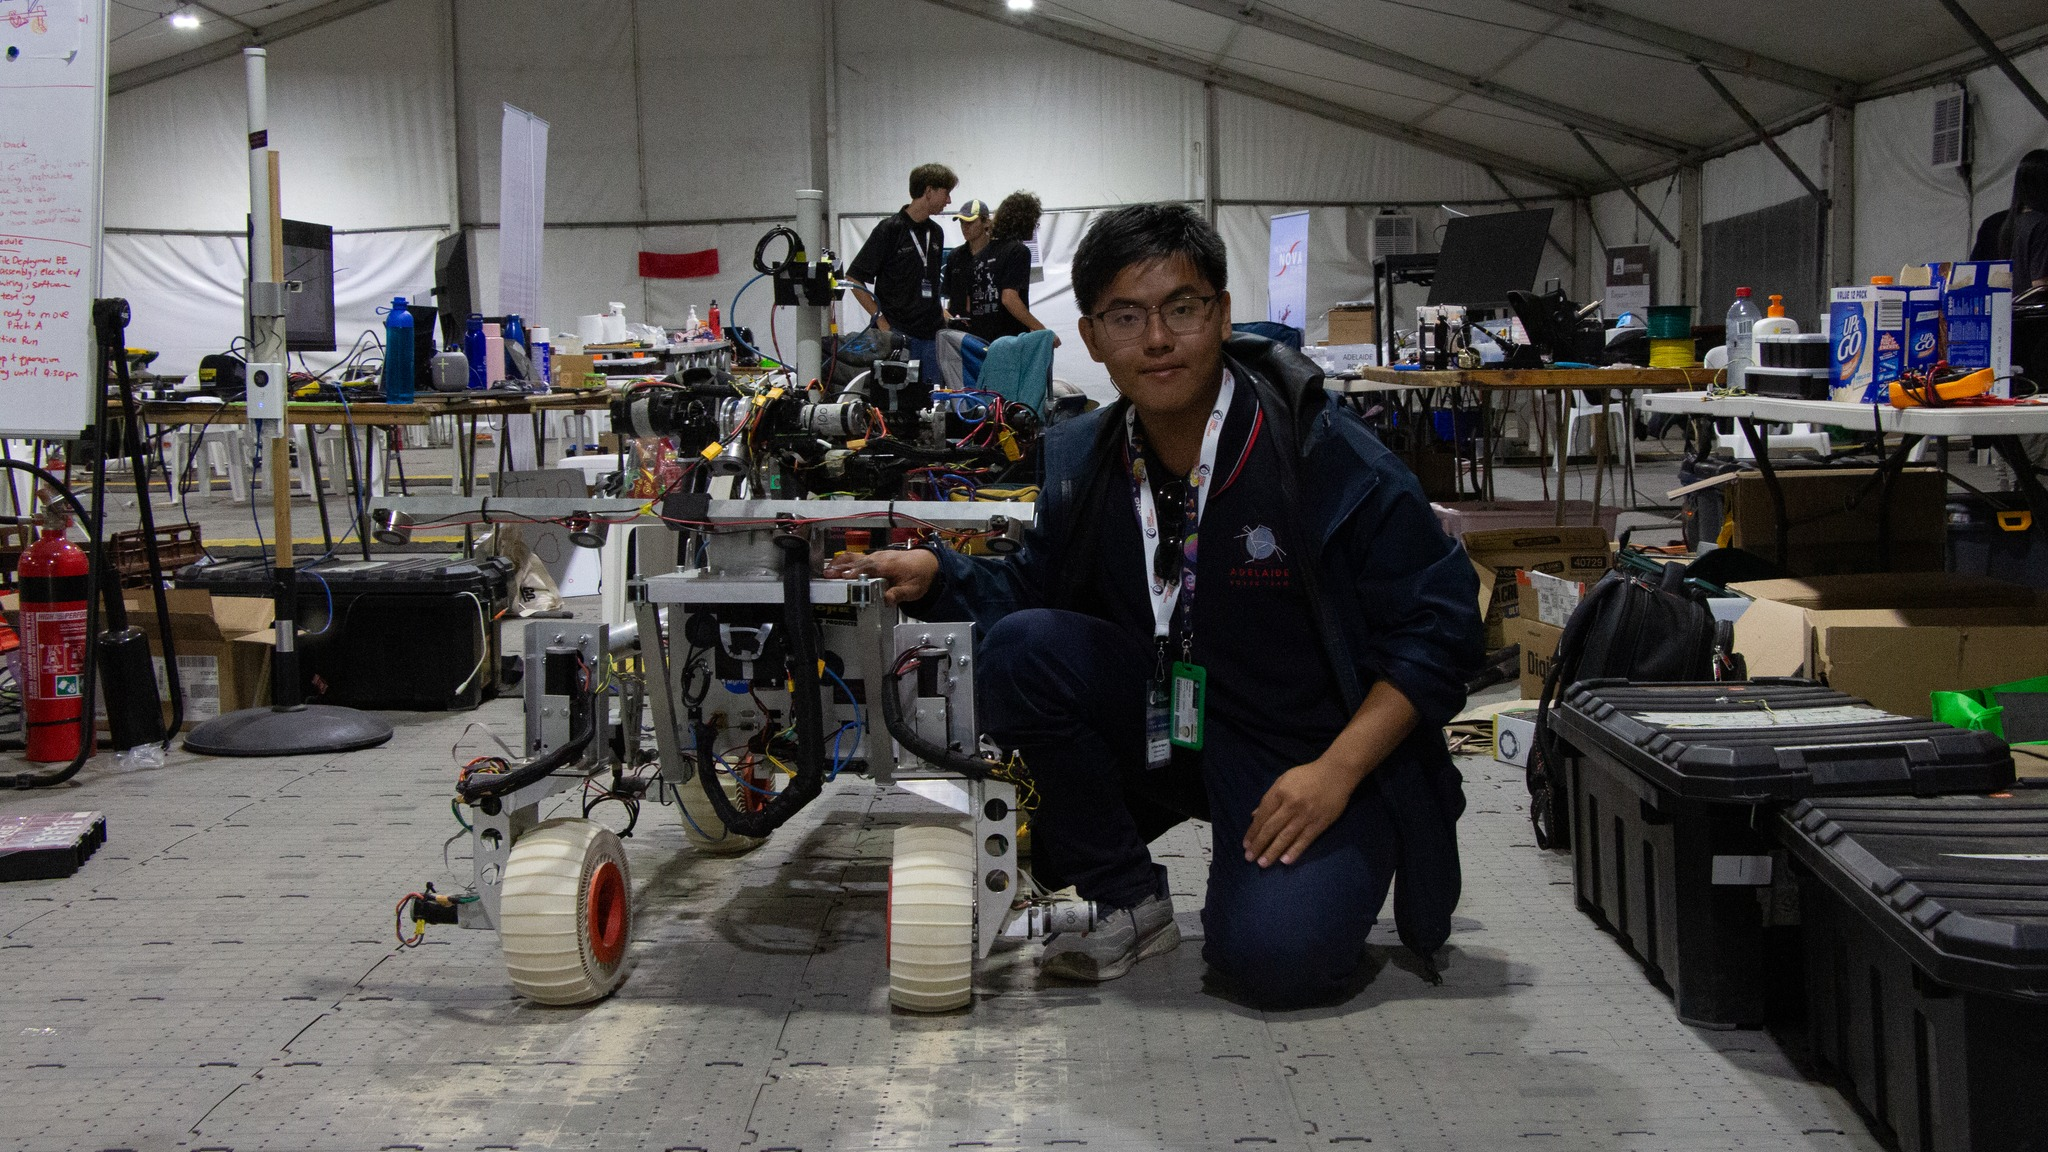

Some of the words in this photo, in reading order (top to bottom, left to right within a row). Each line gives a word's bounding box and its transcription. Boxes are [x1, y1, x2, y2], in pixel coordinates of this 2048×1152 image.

[1279, 251, 1302, 267] NOVA
[1856, 290, 1868, 300] PACK
[27, 309, 36, 318] to
[40, 310, 70, 319] move
[7, 320, 31, 330] Pitch
[34, 320, 43, 331] A
[22, 335, 39, 346] Run
[1837, 330, 1862, 361] GO
[1914, 339, 1936, 352] GO
[1342, 353, 1374, 361] ADELAIDE
[14, 367, 38, 377] until
[1573, 558, 1604, 568] 40729
[1230, 567, 1290, 577] ADELAIDE
